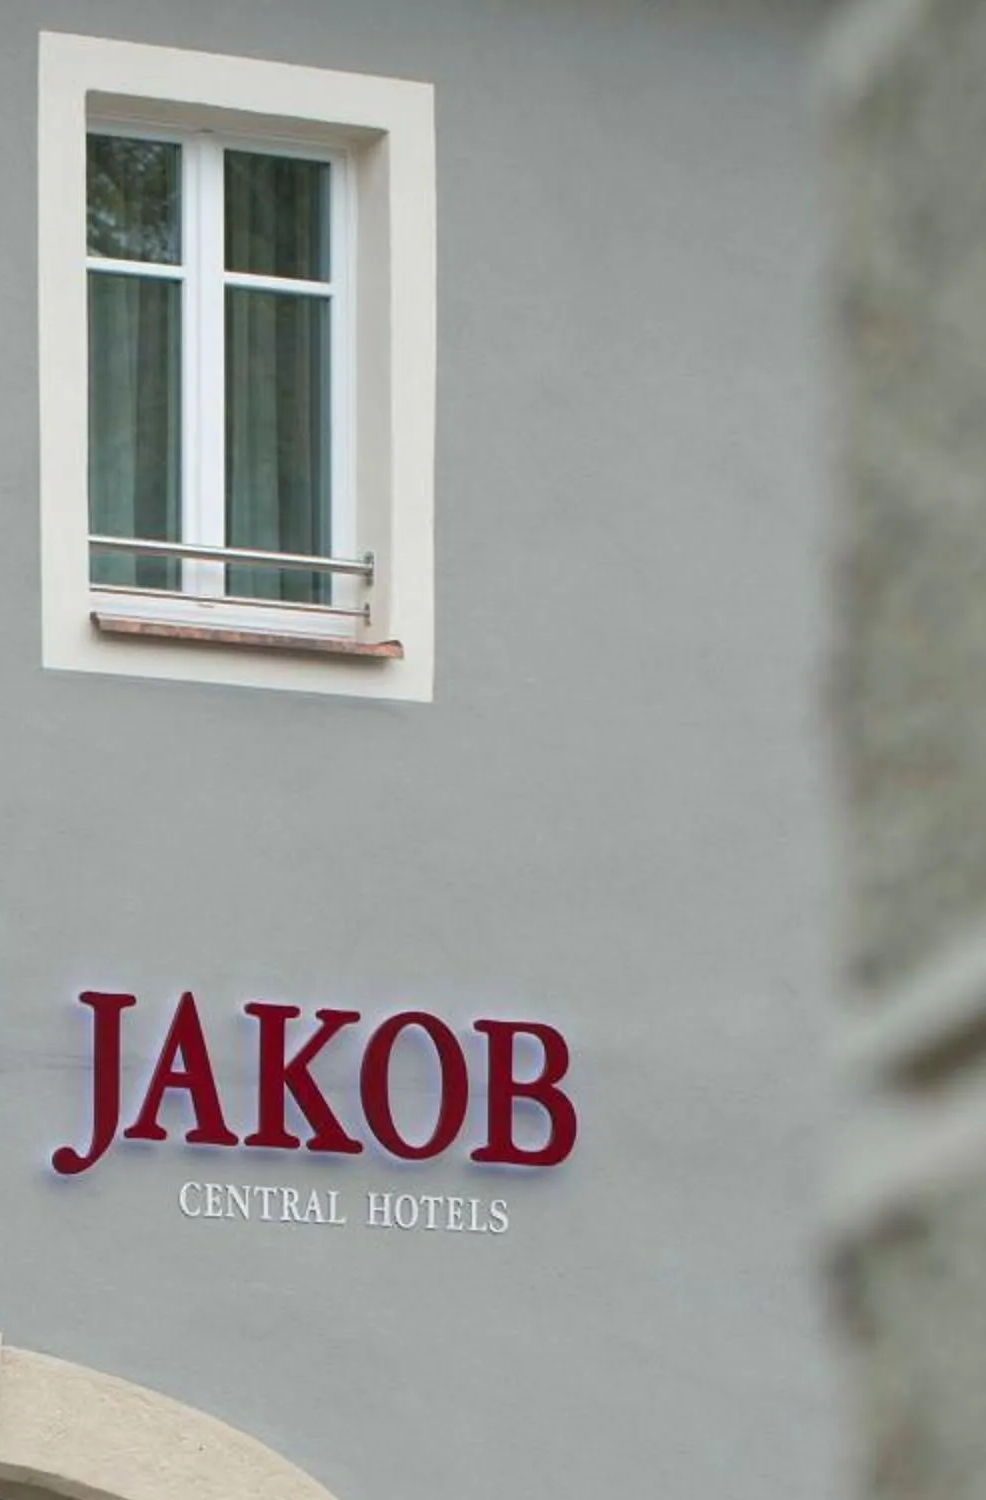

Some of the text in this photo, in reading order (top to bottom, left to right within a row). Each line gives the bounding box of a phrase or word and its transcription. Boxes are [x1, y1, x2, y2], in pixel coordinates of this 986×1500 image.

[51, 991, 577, 1175] JAKOB
[178, 1181, 510, 1234] CENTRAL HOTELS
